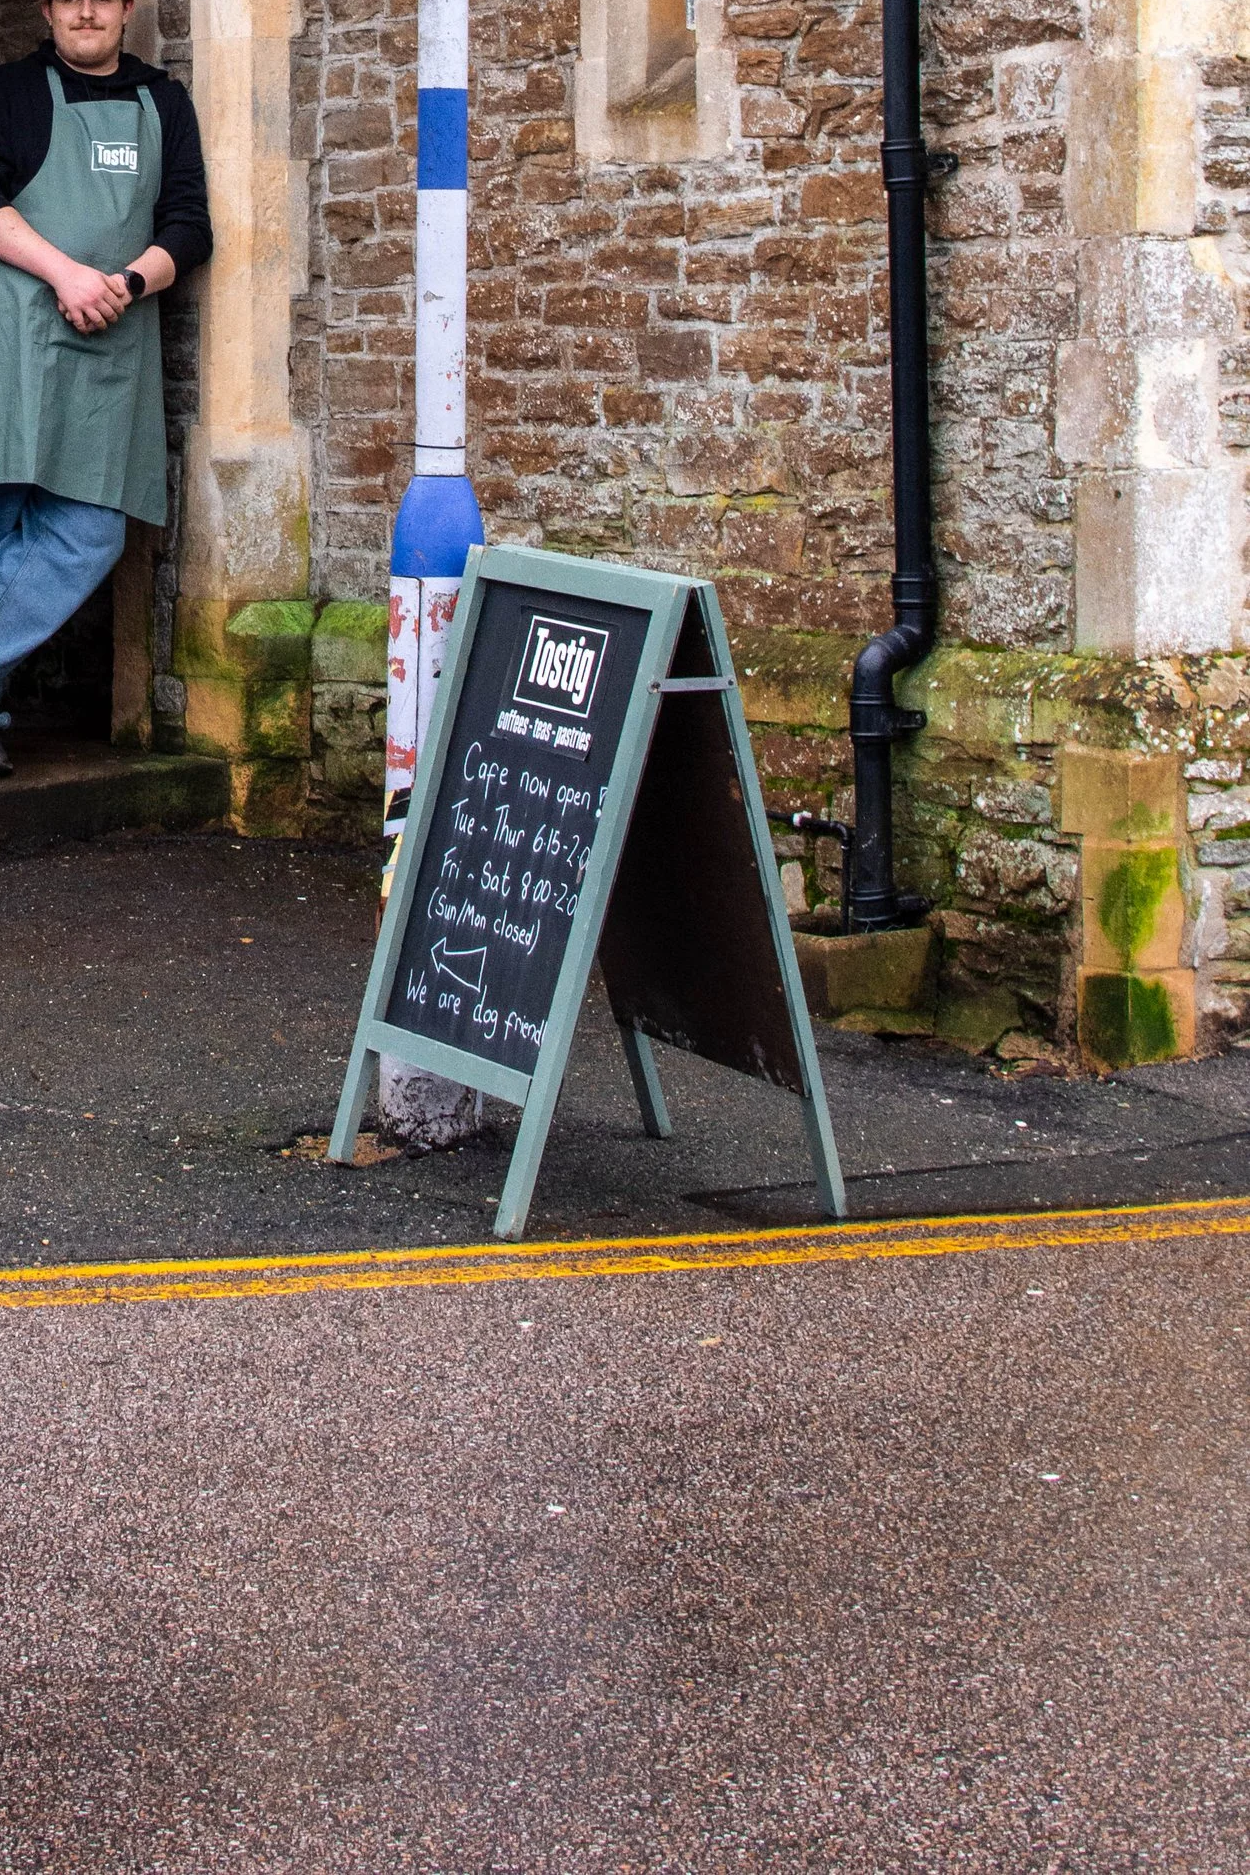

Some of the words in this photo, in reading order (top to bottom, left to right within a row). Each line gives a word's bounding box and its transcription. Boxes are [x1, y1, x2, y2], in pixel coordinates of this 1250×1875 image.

[96, 143, 138, 171] Tostig
[528, 626, 595, 705] Tostig
[497, 708, 529, 737] coffees
[533, 717, 552, 742] teas
[554, 724, 592, 752] pastries
[463, 741, 509, 800] Cafe
[519, 771, 551, 798] now
[452, 798, 475, 836] Tue
[493, 804, 525, 847] Thur
[440, 847, 462, 880] Fri
[481, 860, 511, 897] Sat
[427, 887, 486, 930] (Sun/Mon
[493, 910, 541, 955] closed)
[406, 968, 427, 1004] We
[438, 991, 461, 1014] are
[473, 984, 499, 1039] dog
